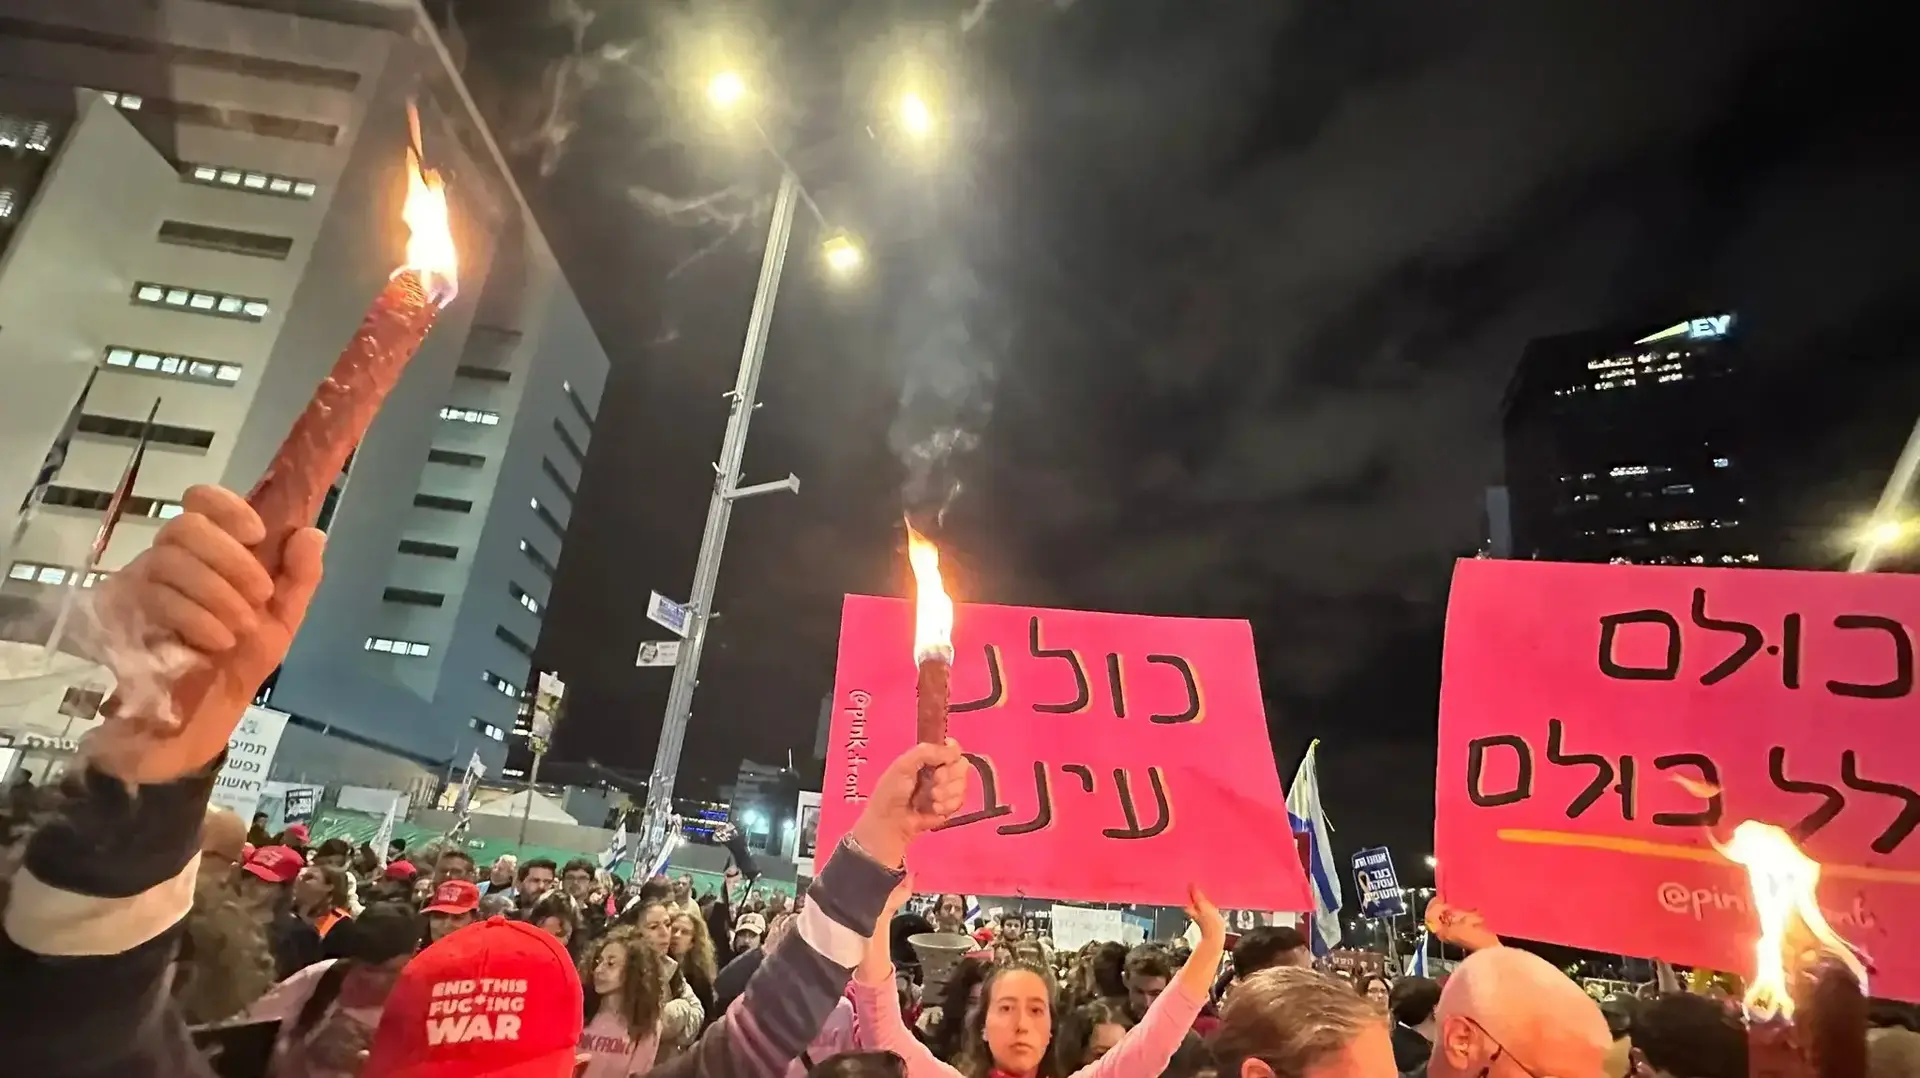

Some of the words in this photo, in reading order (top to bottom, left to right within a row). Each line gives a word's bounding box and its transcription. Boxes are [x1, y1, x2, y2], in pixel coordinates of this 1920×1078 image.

[1691, 314, 1731, 338] EY
[947, 616, 1203, 724] כולנ
[228, 739, 267, 756] תמיכ
[229, 758, 261, 773] נפש
[432, 979, 476, 997] END
[480, 978, 528, 994] THIS
[426, 1014, 522, 1046] WAR
